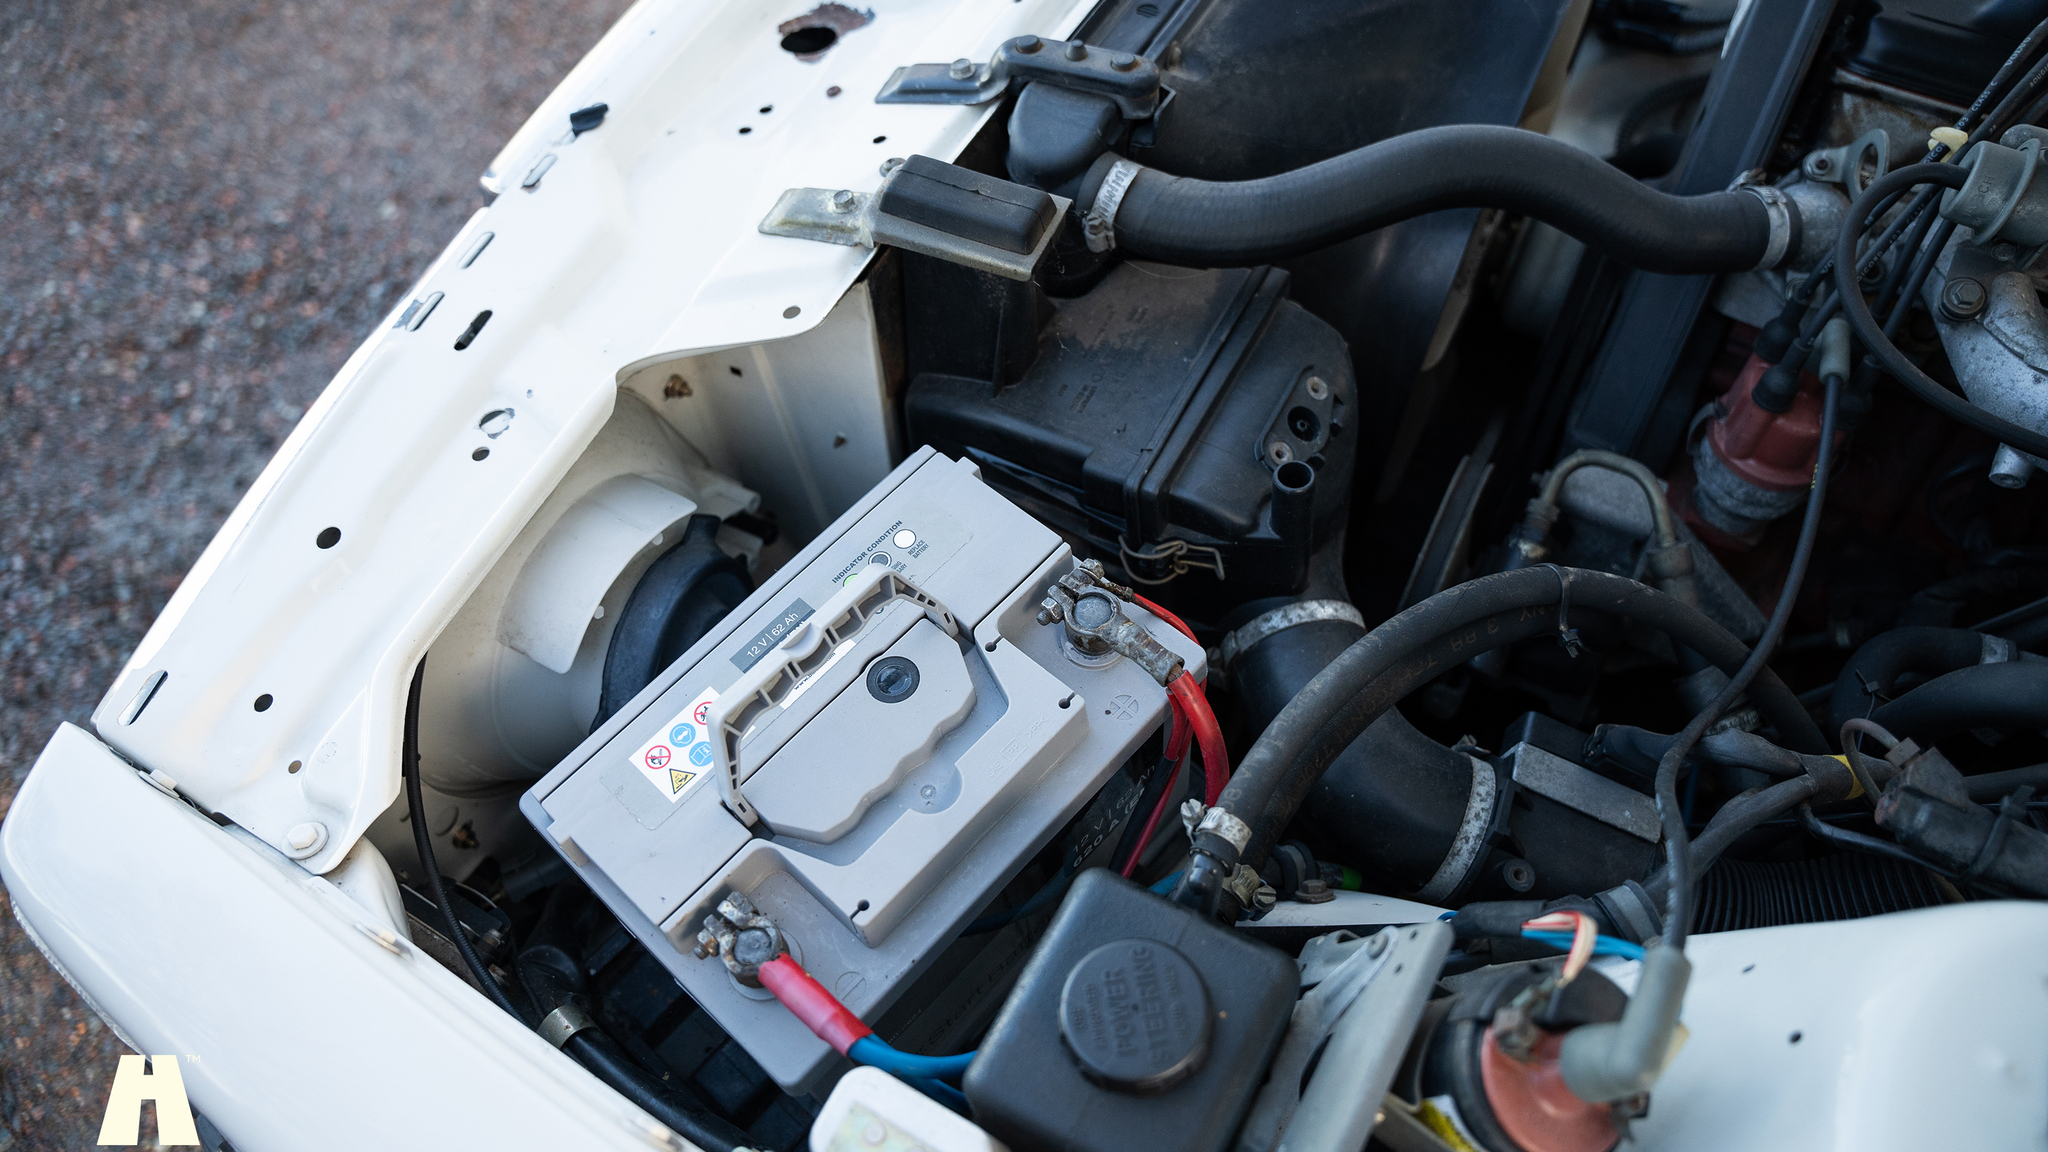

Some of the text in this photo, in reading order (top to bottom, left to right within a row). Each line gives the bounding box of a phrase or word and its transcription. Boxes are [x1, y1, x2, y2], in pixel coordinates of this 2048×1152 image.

[1970, 89, 1991, 112] CLASS
[1905, 202, 1926, 225] CLASS
[832, 520, 903, 584] INDICATOR CONDITION
[907, 539, 926, 556] REPLACE
[912, 543, 930, 559] BATTERY
[746, 645, 761, 658] 12
[757, 638, 768, 649] V
[771, 623, 786, 636] 62
[784, 612, 799, 626] Ah
[985, 760, 1004, 777] SAE
[1007, 744, 1020, 756] PP
[1072, 834, 1089, 853] 12
[1094, 818, 1104, 831] V
[1116, 788, 1133, 809] 62
[1137, 765, 1155, 788] Ah
[1073, 834, 1103, 867] 620
[1108, 819, 1119, 832] A
[928, 986, 984, 1045] Start
[1104, 966, 1140, 1057] POWER
[1132, 946, 1172, 1066] STEERING
